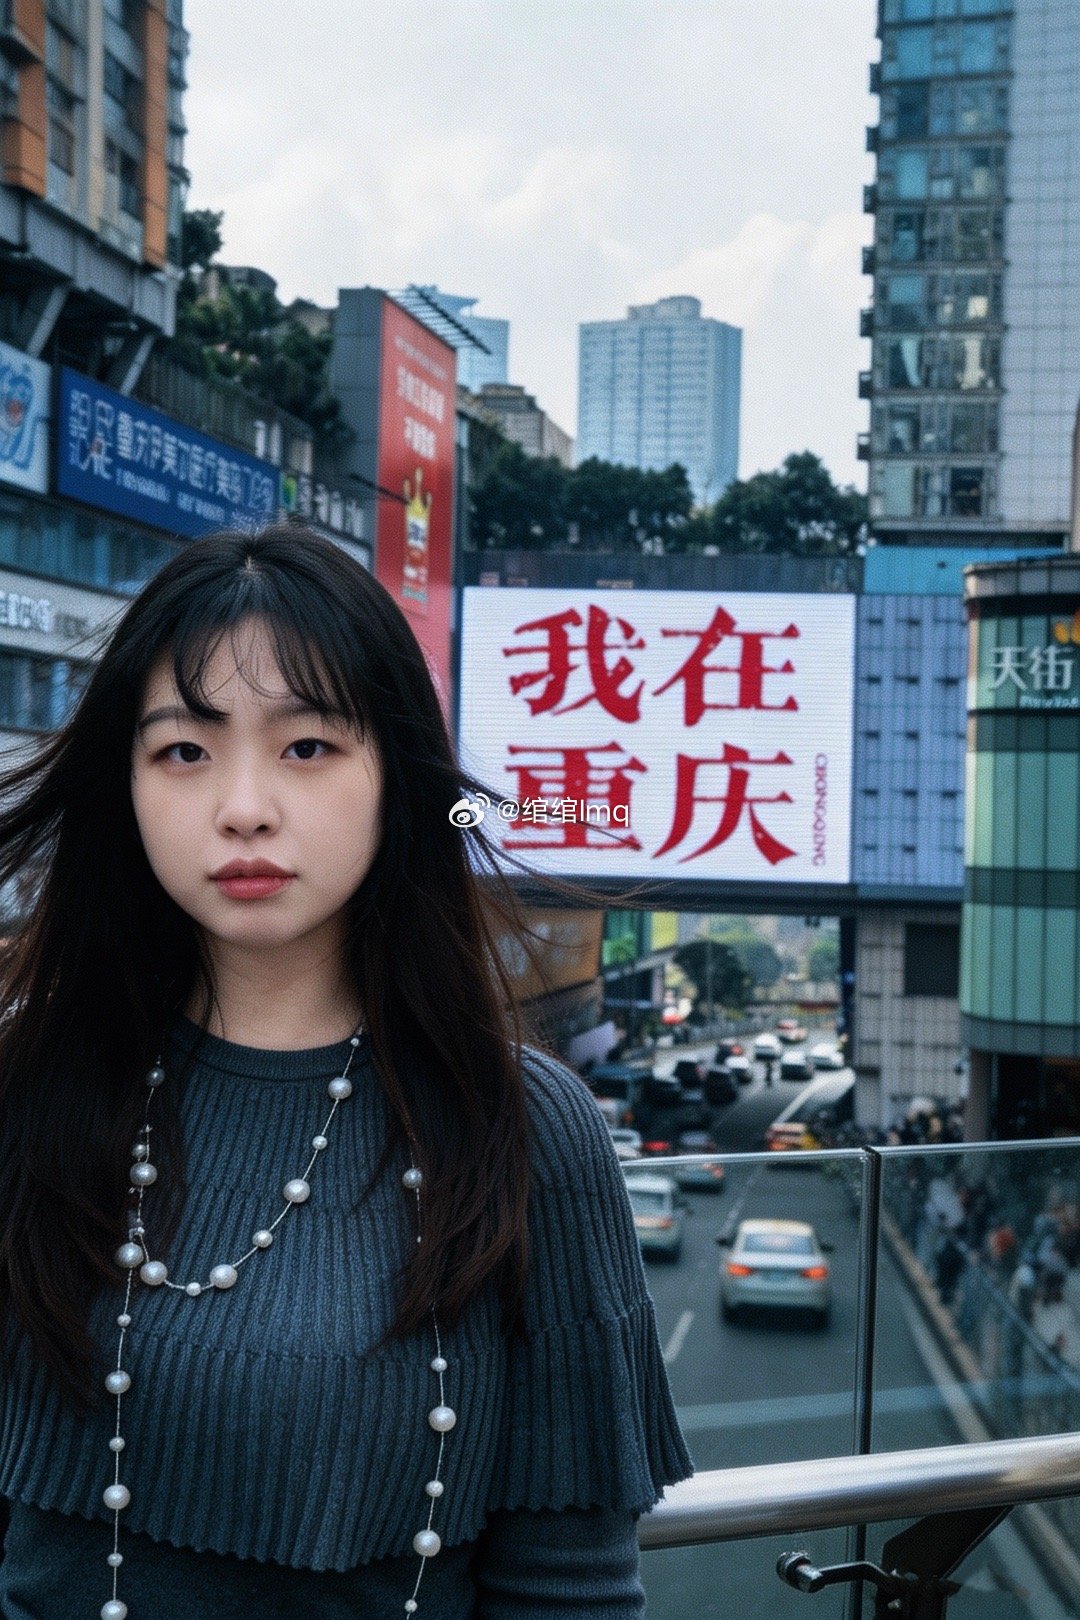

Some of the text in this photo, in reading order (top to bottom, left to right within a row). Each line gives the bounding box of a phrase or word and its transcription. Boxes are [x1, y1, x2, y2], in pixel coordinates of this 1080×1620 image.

[502, 603, 801, 728] 我在
[989, 645, 1074, 691] 天街
[502, 740, 799, 866] 重庆
